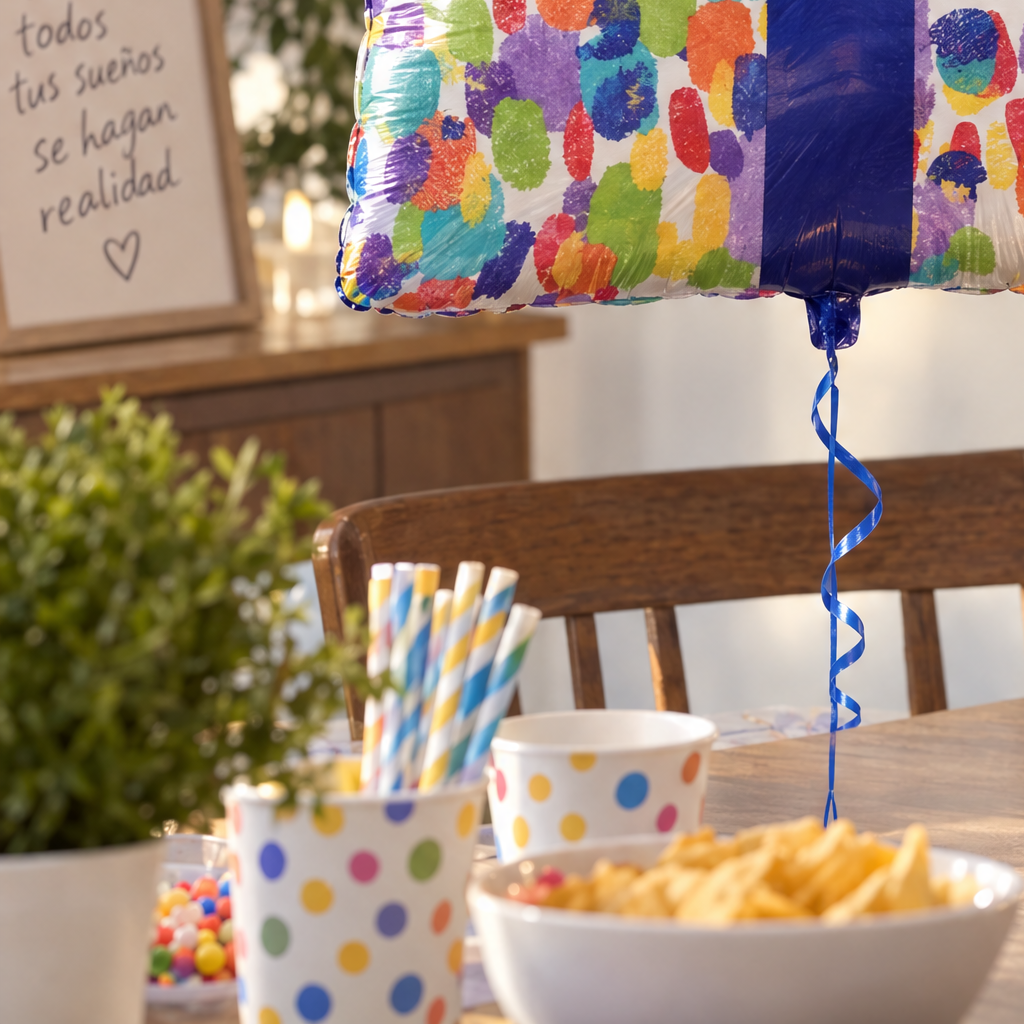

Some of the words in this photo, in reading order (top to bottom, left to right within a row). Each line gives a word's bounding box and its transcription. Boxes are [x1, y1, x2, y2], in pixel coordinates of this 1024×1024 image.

[15, 2, 108, 57] todos
[8, 70, 60, 114] tus
[74, 43, 166, 97] sueños
[33, 136, 69, 174] se
[81, 101, 177, 159] hagan
[40, 146, 181, 233] realidad
